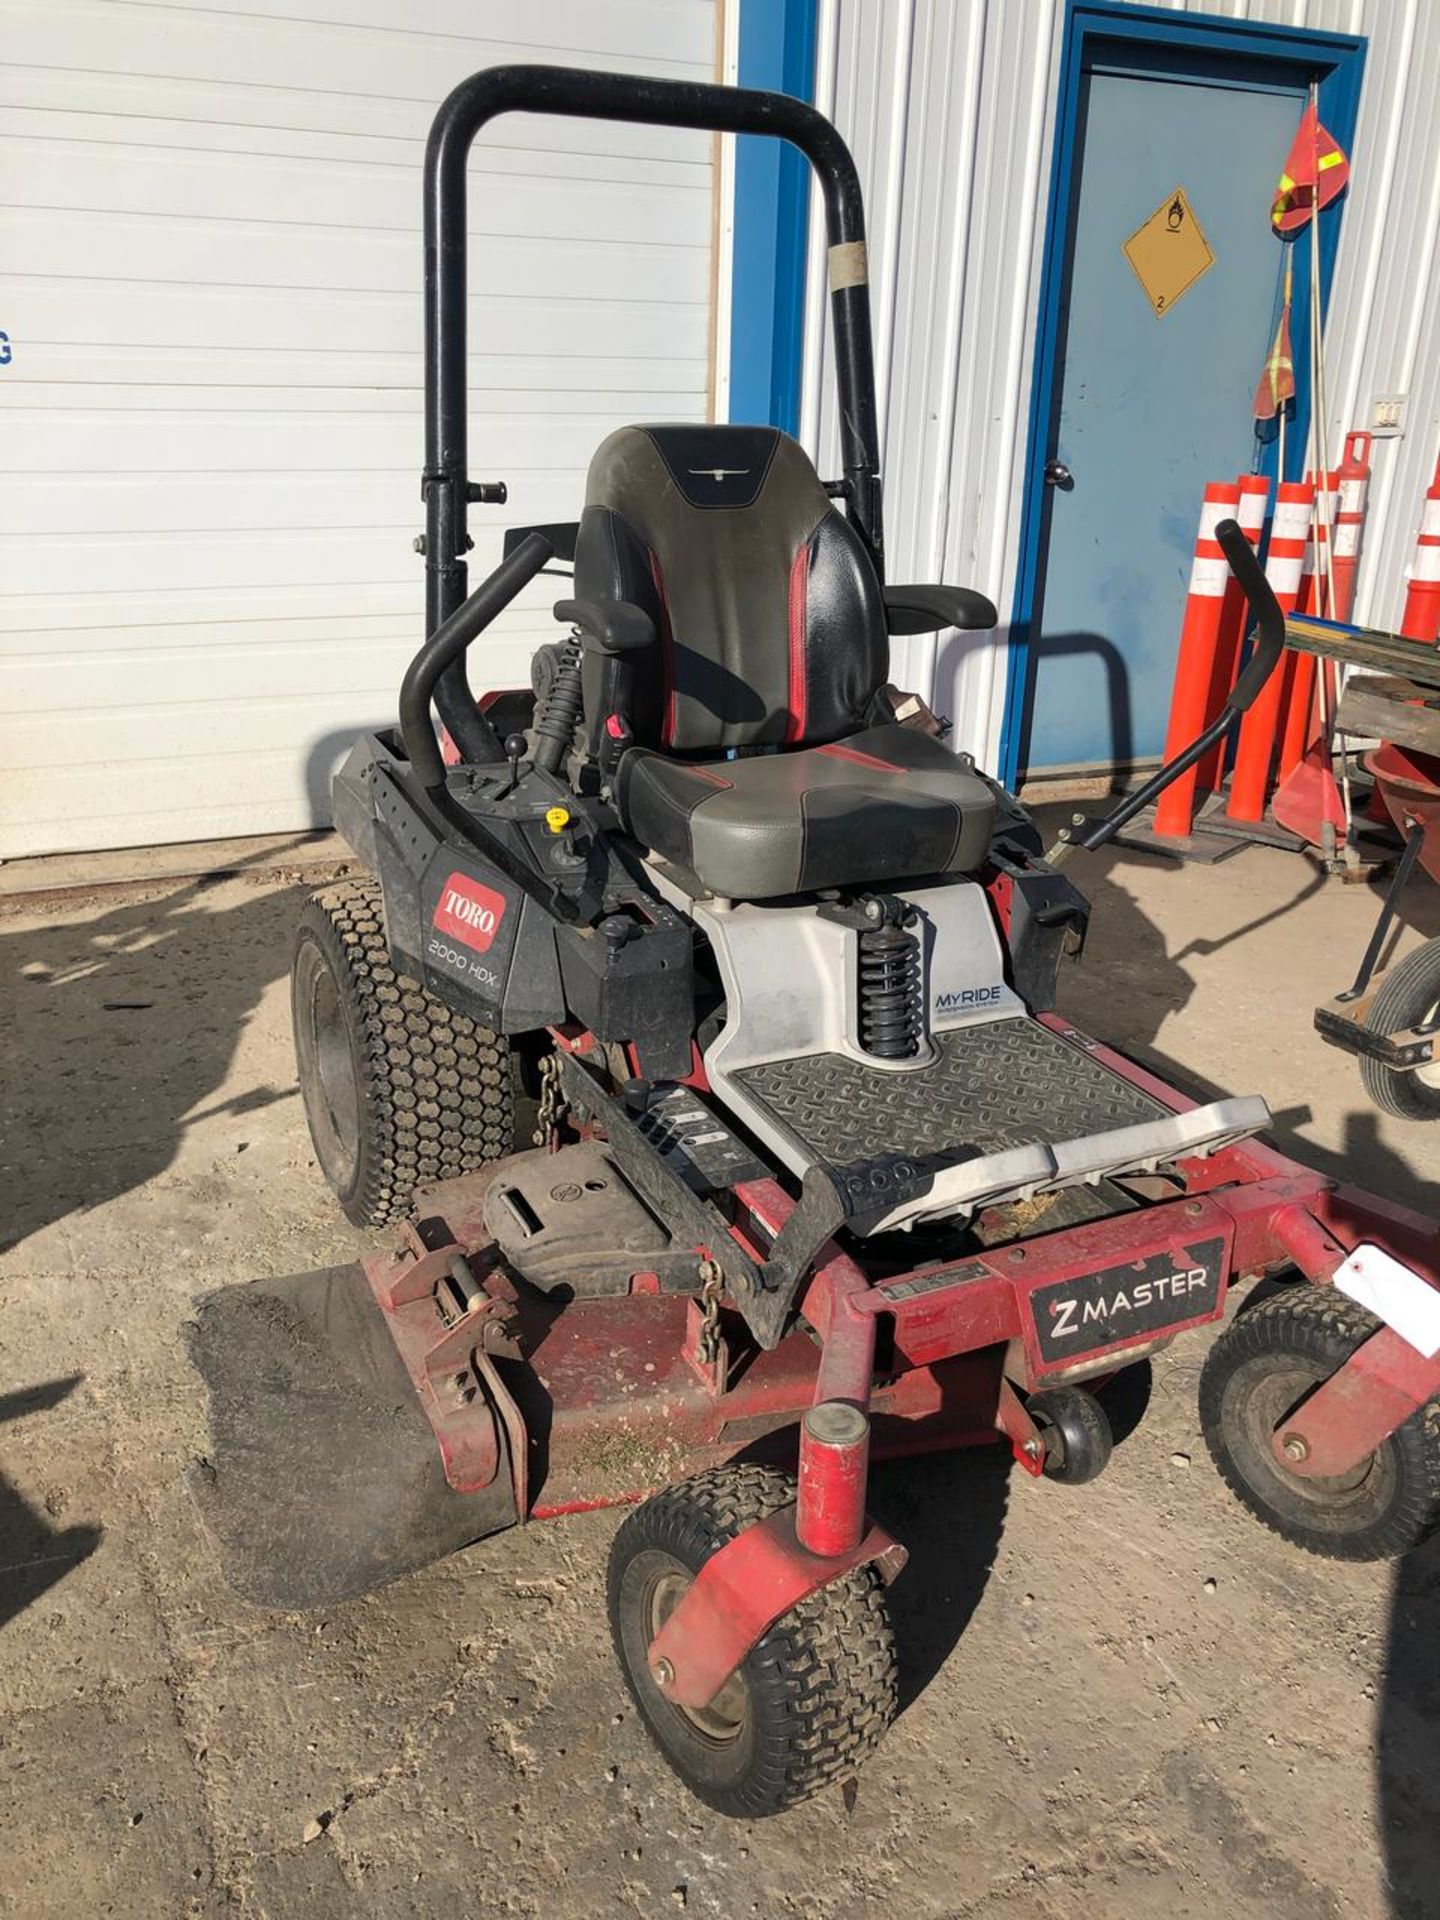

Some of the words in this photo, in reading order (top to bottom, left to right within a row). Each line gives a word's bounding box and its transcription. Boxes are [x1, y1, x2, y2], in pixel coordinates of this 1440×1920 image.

[1157, 295, 1165, 309] 2
[443, 889, 495, 933] TORO
[428, 939, 467, 969] 2000
[468, 961, 499, 987] HDX
[1050, 1299, 1079, 1339] Z
[1082, 1268, 1207, 1324] MASTER
